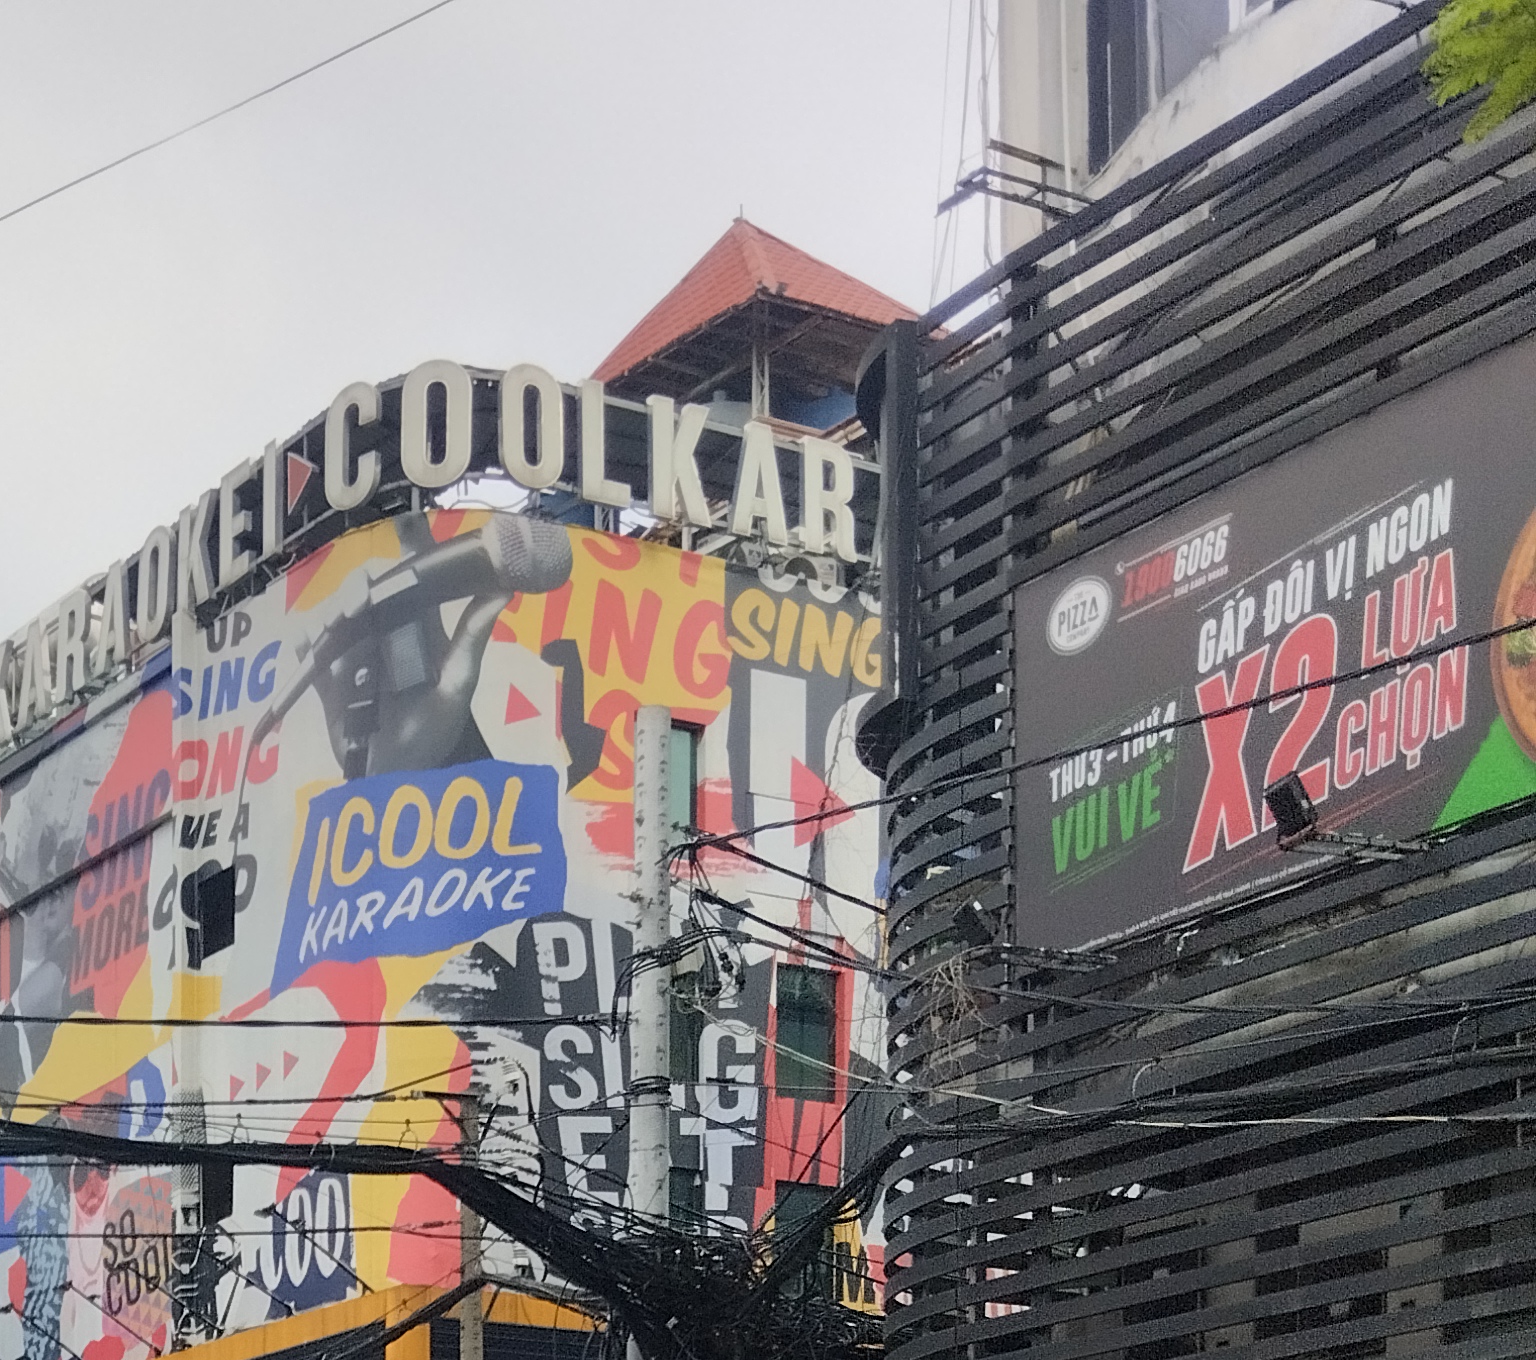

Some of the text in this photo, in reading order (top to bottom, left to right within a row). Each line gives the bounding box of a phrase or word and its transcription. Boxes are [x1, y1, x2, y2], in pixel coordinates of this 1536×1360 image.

[1263, 558, 1315, 638] ĐÔI
[1325, 534, 1357, 601] VỊ
[1365, 477, 1454, 579] NGON
[726, 588, 883, 688] SING
[1057, 596, 1100, 638] PIZZA
[1182, 613, 1339, 875] X2
[1333, 644, 1470, 791] CHỌN
[307, 775, 543, 908] ICOOL
[1051, 785, 1110, 875] VUI
[298, 866, 537, 964] KARAOKE
